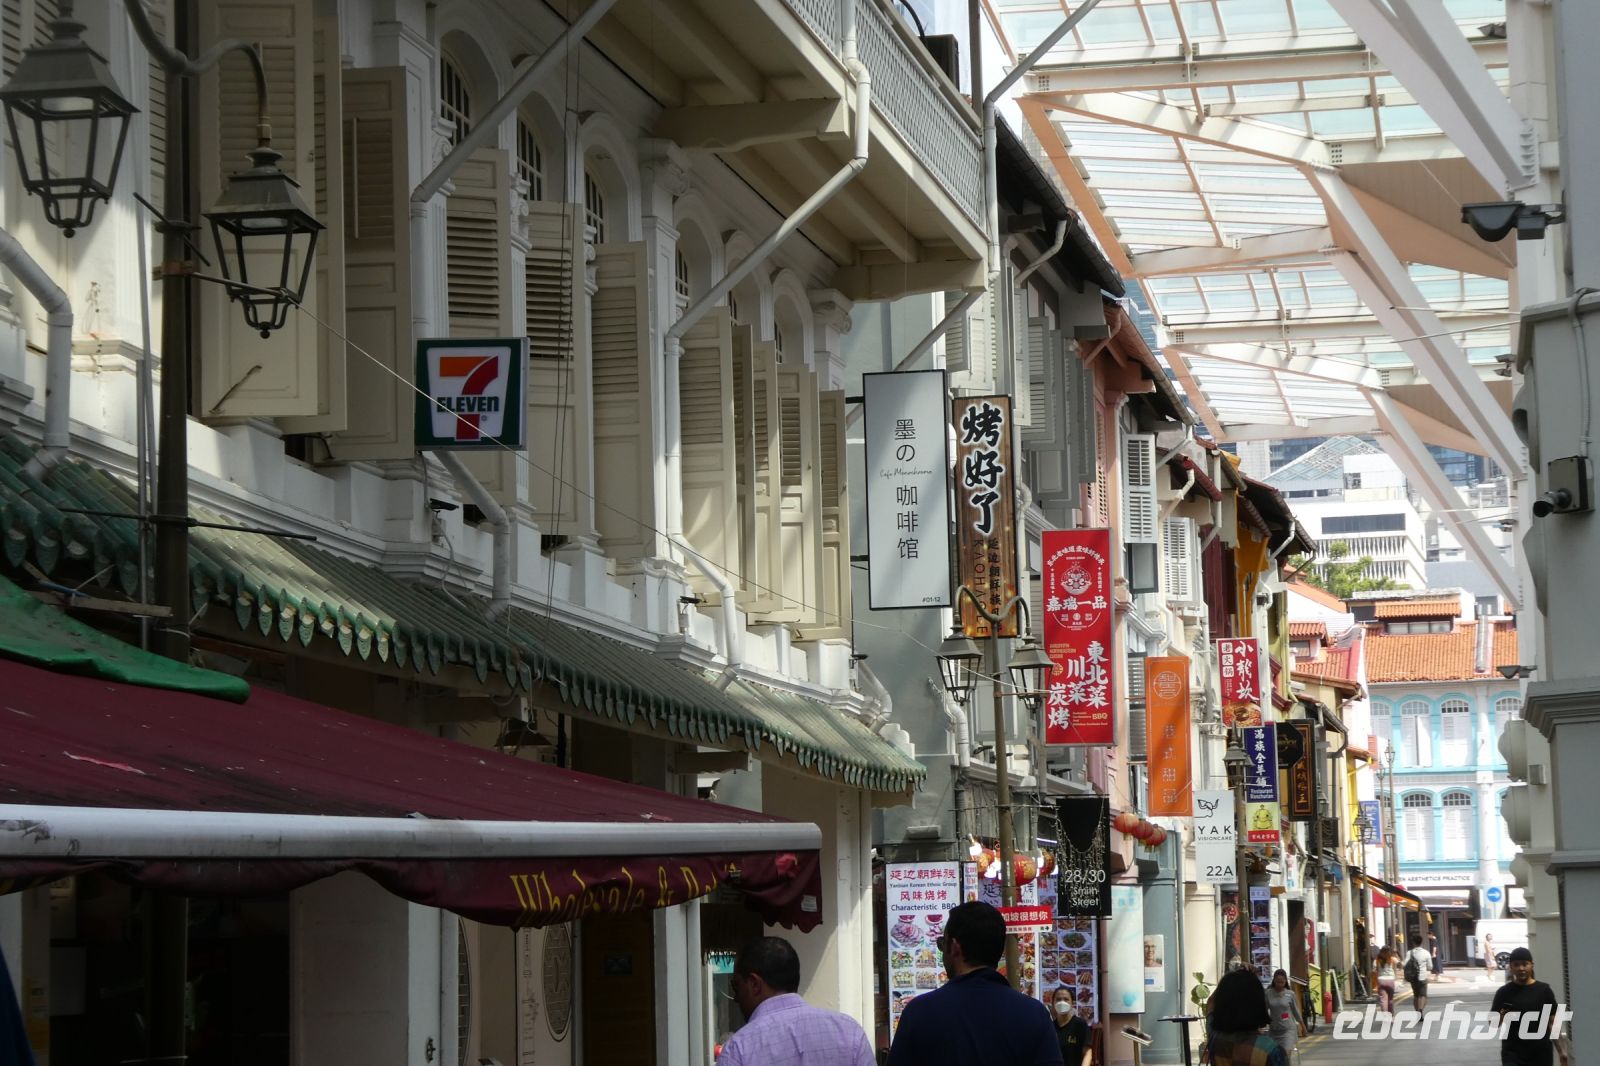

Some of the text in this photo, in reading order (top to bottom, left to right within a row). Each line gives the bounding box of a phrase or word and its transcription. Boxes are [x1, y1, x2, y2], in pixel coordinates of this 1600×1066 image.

[962, 402, 1004, 533] 烤好了
[1046, 595, 1107, 612] 嘉瑞一品
[1047, 682, 1070, 730] 炭烤
[1092, 712, 1108, 720] BBQ
[1064, 869, 1106, 884] 28/30
[1206, 865, 1233, 877] 22A
[900, 889, 948, 901] 风味烧烤
[1073, 886, 1098, 896] Smith
[890, 902, 957, 911] Characteristic BBQ
[1072, 897, 1099, 906] Street
